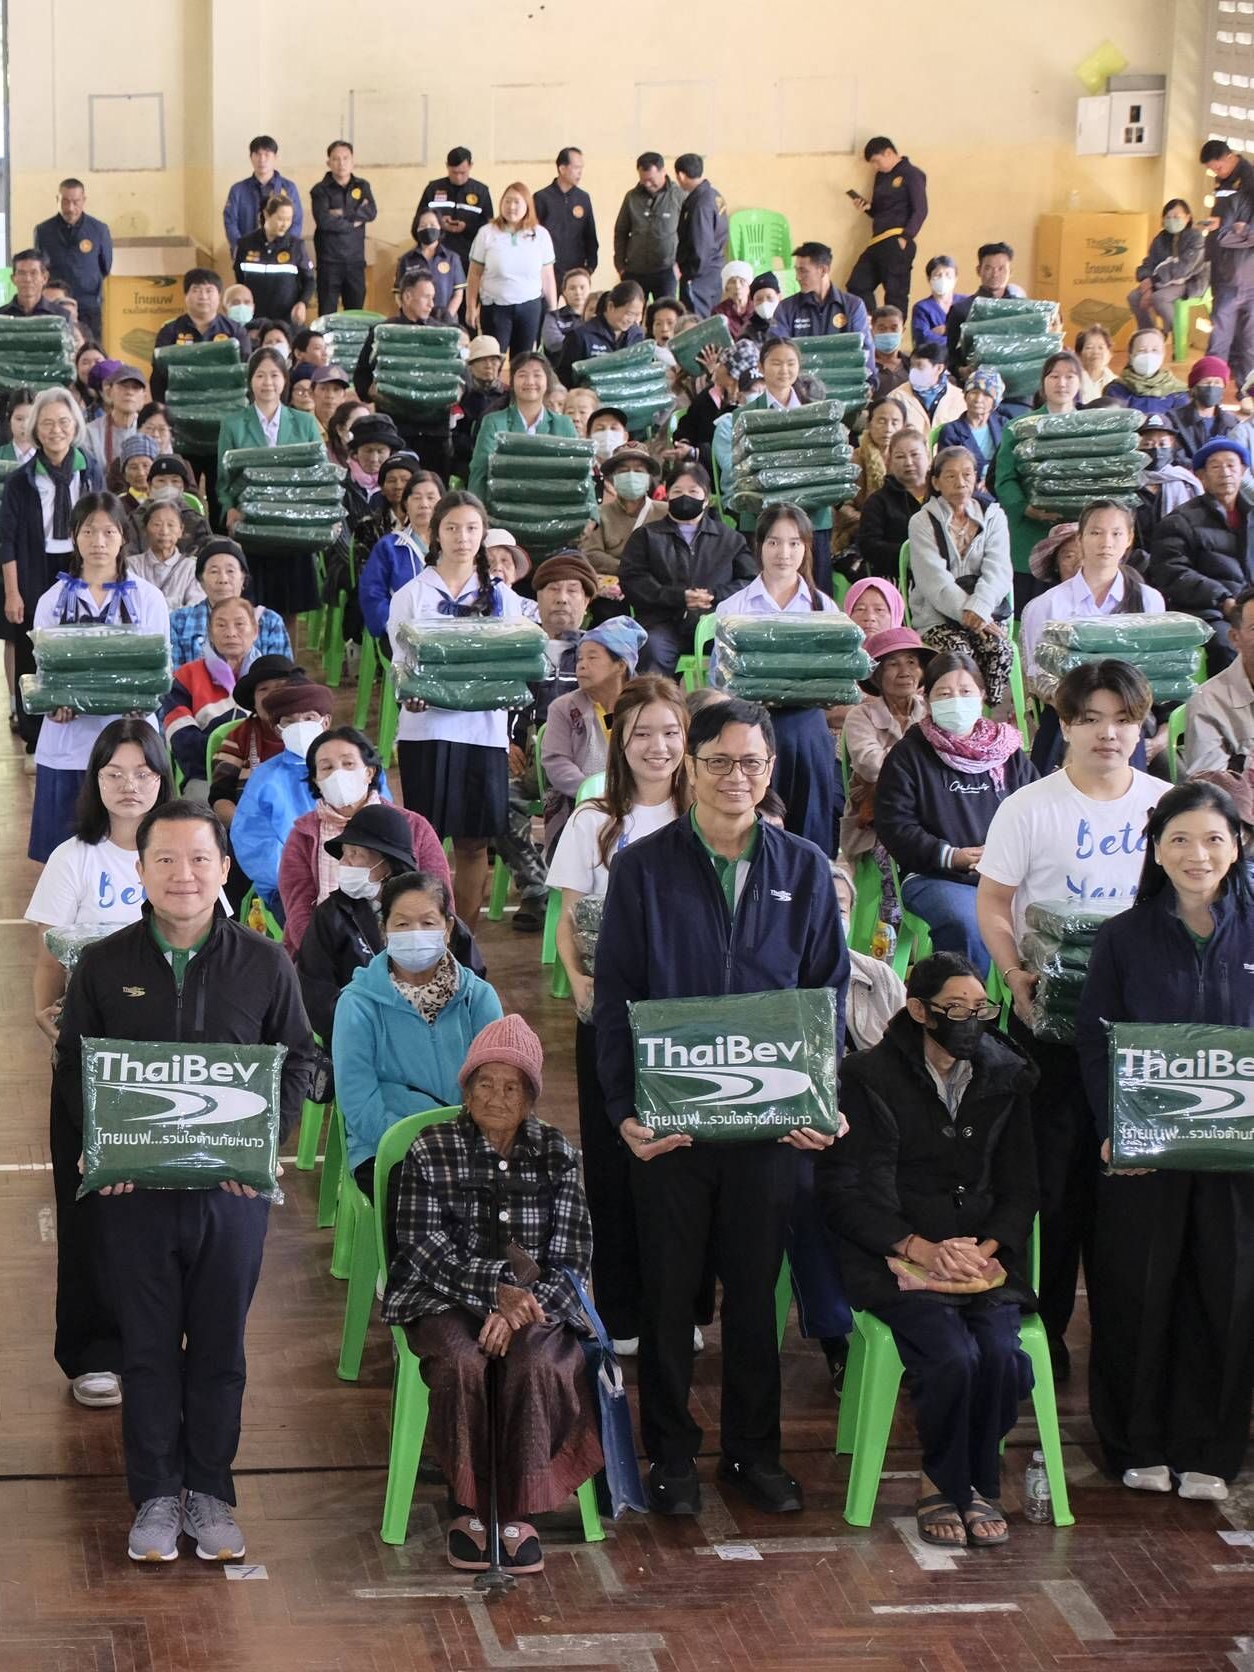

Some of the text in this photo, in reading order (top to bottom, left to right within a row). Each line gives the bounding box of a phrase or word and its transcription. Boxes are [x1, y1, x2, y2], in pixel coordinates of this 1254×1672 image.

[95, 1051, 259, 1083] ThaiBev
[639, 1035, 802, 1067] ThaiBev
[1117, 1048, 1254, 1079] ThaiBe
